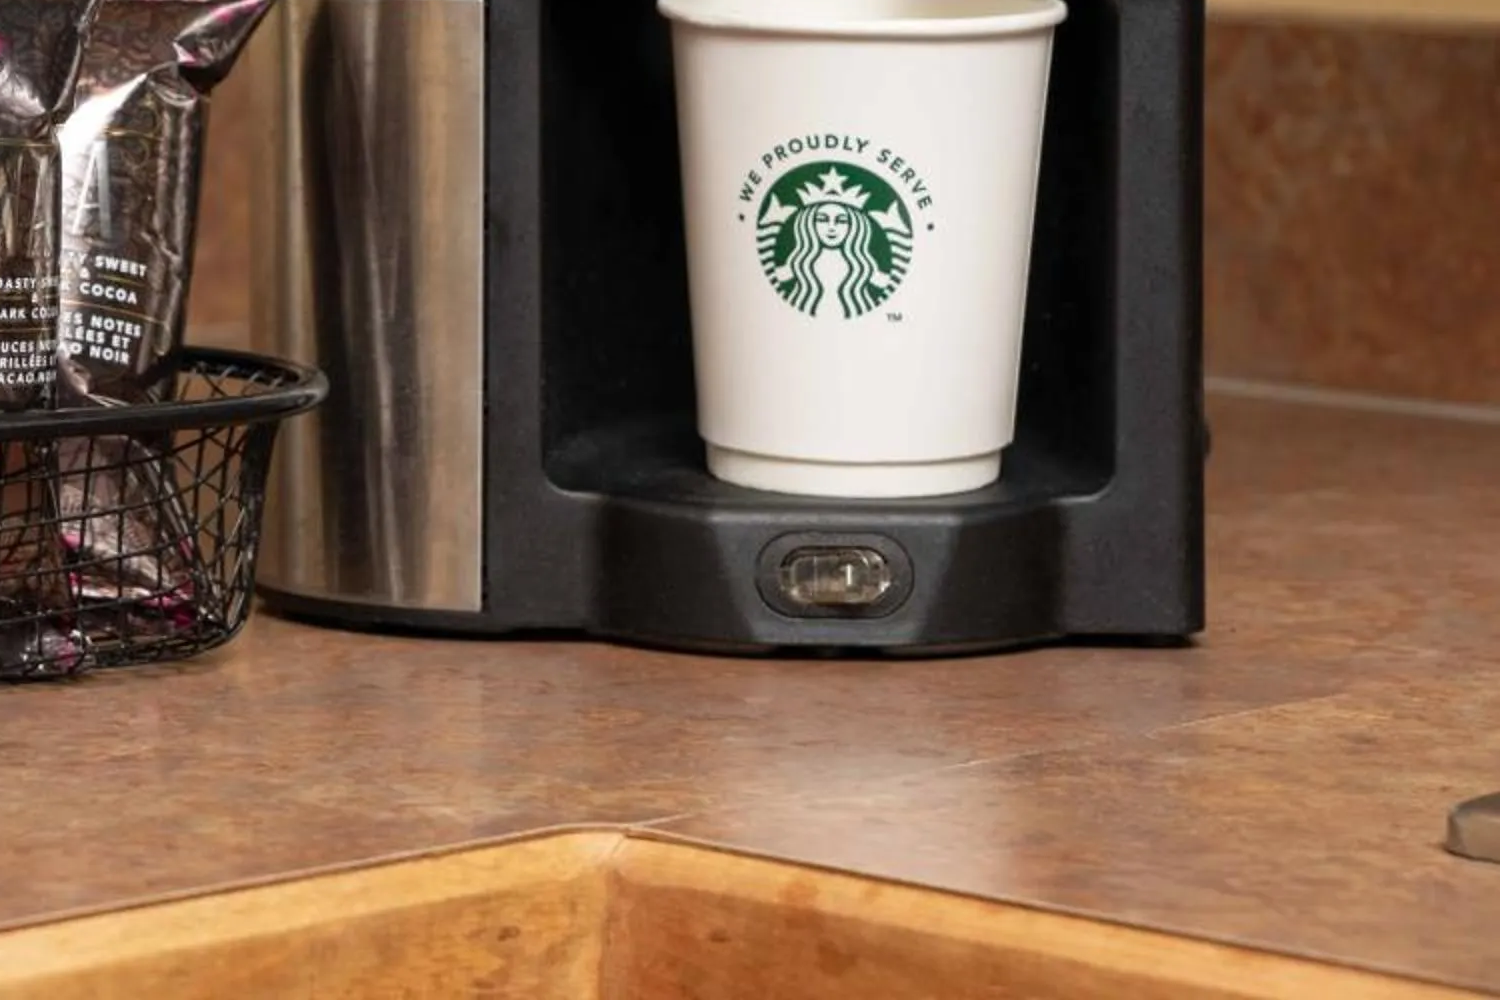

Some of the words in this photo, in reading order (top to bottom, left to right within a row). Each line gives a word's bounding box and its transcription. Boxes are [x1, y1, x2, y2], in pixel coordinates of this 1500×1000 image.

[739, 170, 762, 202] WE
[762, 133, 870, 169] PROUDLY
[876, 149, 933, 210] SERVE
[94, 255, 147, 277] SWEET
[79, 281, 138, 305] COCOA
[90, 314, 141, 338] NOTES
[111, 334, 132, 350] ET
[88, 345, 130, 365] NOIR
